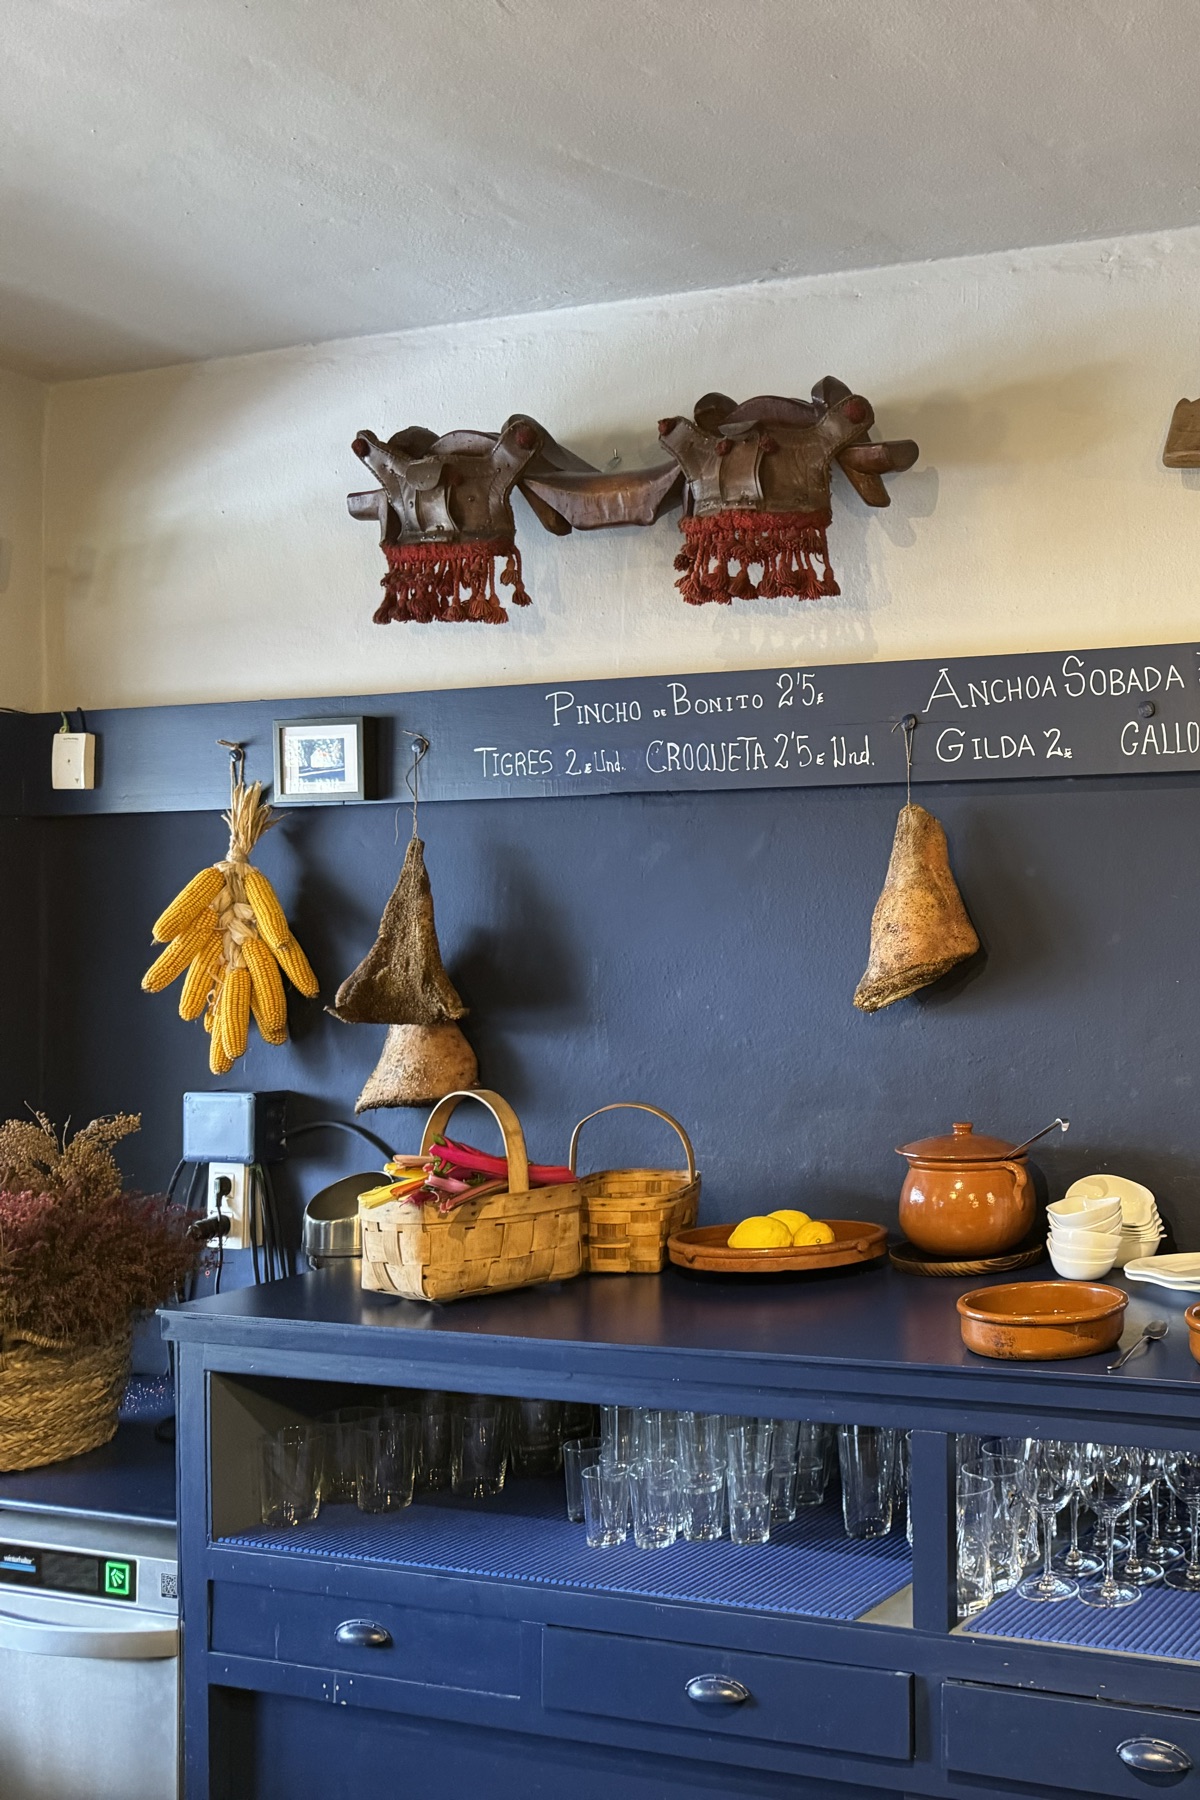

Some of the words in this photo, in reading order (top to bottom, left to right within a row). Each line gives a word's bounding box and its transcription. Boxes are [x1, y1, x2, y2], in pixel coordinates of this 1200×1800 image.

[922, 668, 1057, 713] ANCHOA
[1062, 655, 1185, 697] SOBADA
[546, 691, 642, 726] PINCHO
[653, 709, 667, 718] DE
[667, 683, 764, 716] BONITO
[474, 747, 553, 777] TIGRES
[646, 735, 769, 773] CROQUETA
[936, 728, 1036, 763] GILDA
